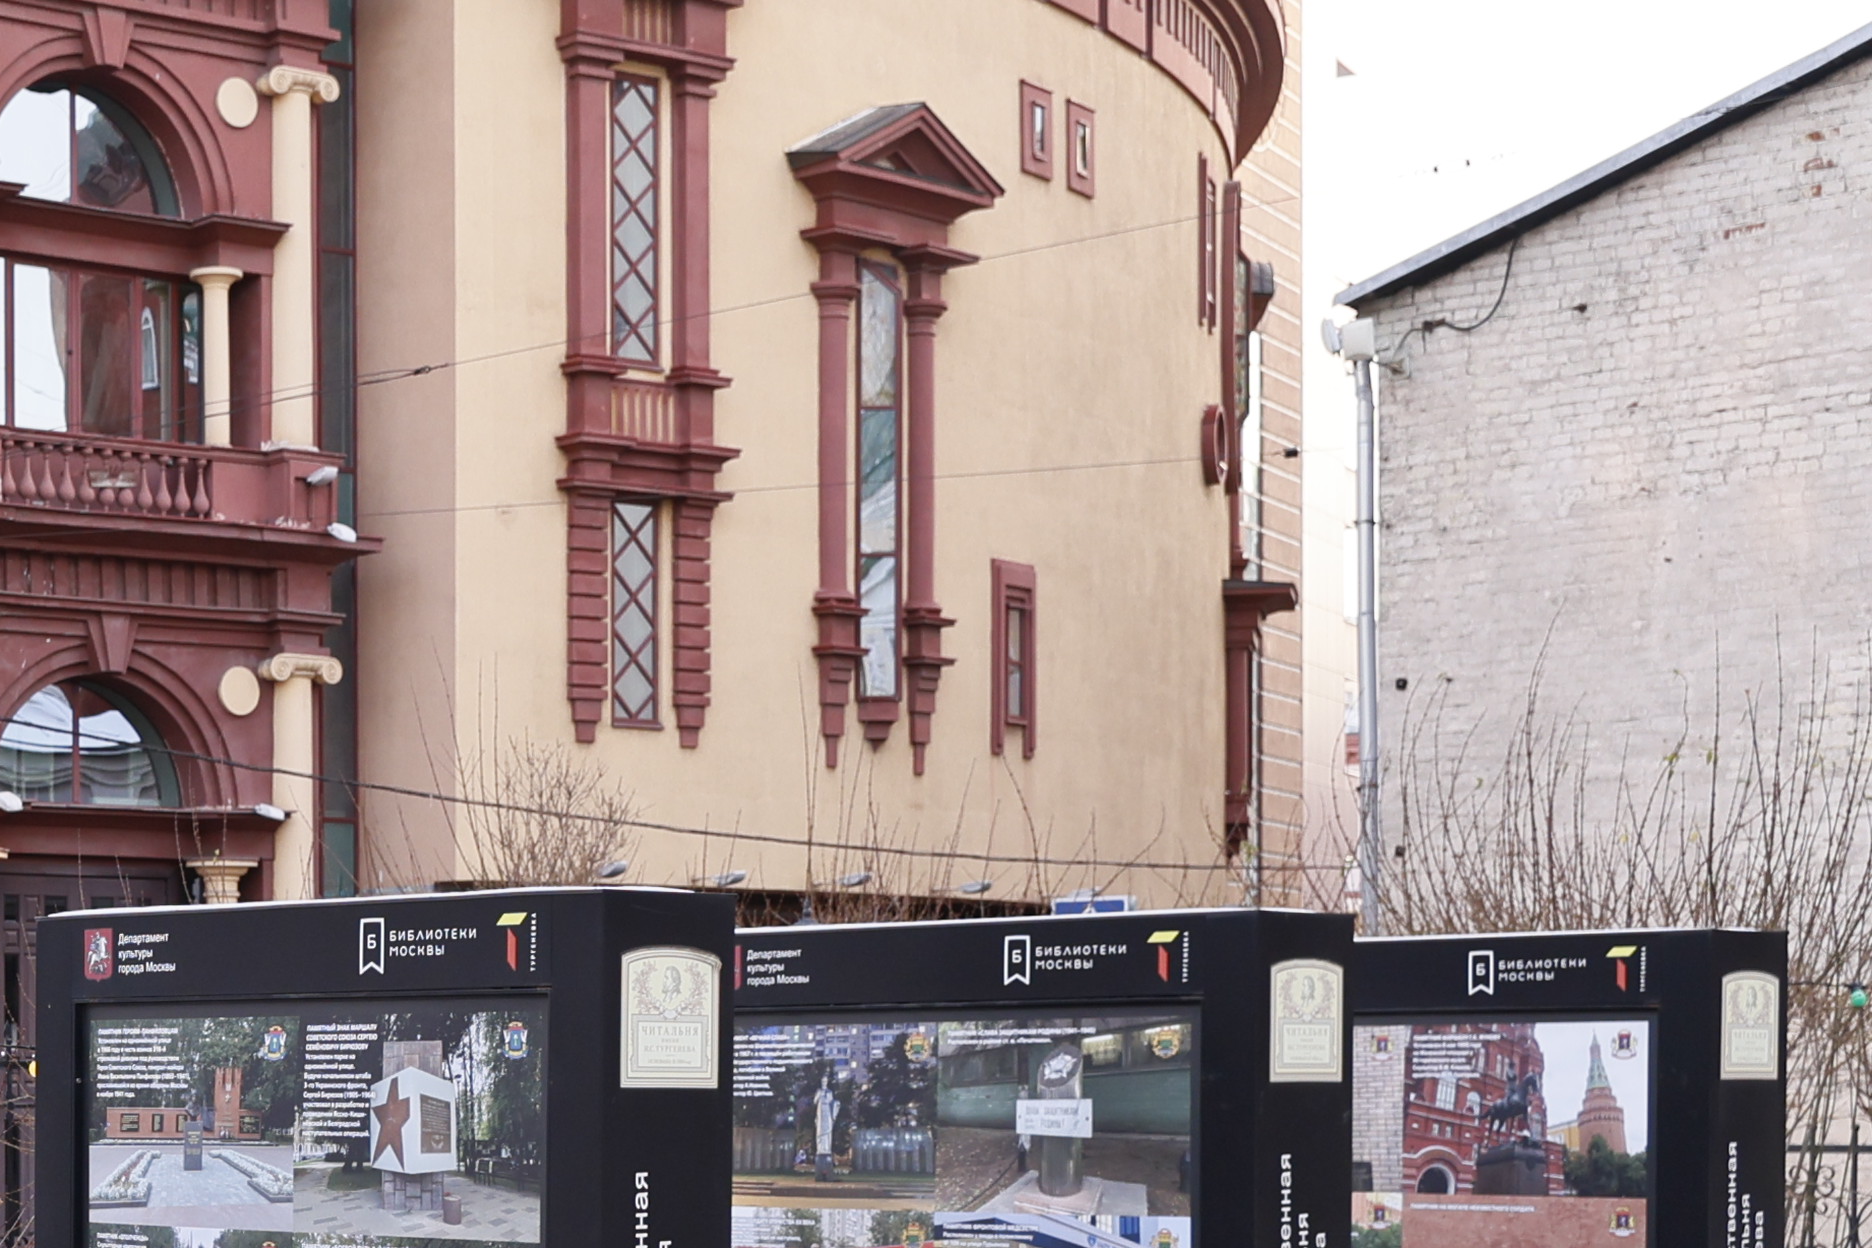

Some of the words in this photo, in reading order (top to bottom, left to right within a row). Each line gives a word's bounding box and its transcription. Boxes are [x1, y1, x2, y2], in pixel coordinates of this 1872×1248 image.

[117, 932, 169, 947] Департамент
[388, 927, 478, 942] БИБЛИОТЕКИ
[118, 949, 154, 962] культуры
[388, 944, 445, 957] МОСКВЫ
[746, 948, 802, 961] Департамент
[1034, 944, 1128, 957] БИБЛИОТЕКИ
[118, 963, 144, 976] города
[145, 961, 176, 973] Москвы
[746, 963, 784, 975] культуры
[1034, 959, 1095, 970] МОСКВЫ
[1498, 957, 1587, 971] БИБЛИОТЕКИ
[746, 976, 775, 988] города
[776, 974, 811, 985] Москвы
[1498, 971, 1555, 982] МОСКВЫ
[641, 1026, 699, 1037] ЧИТАЛЬНЯ
